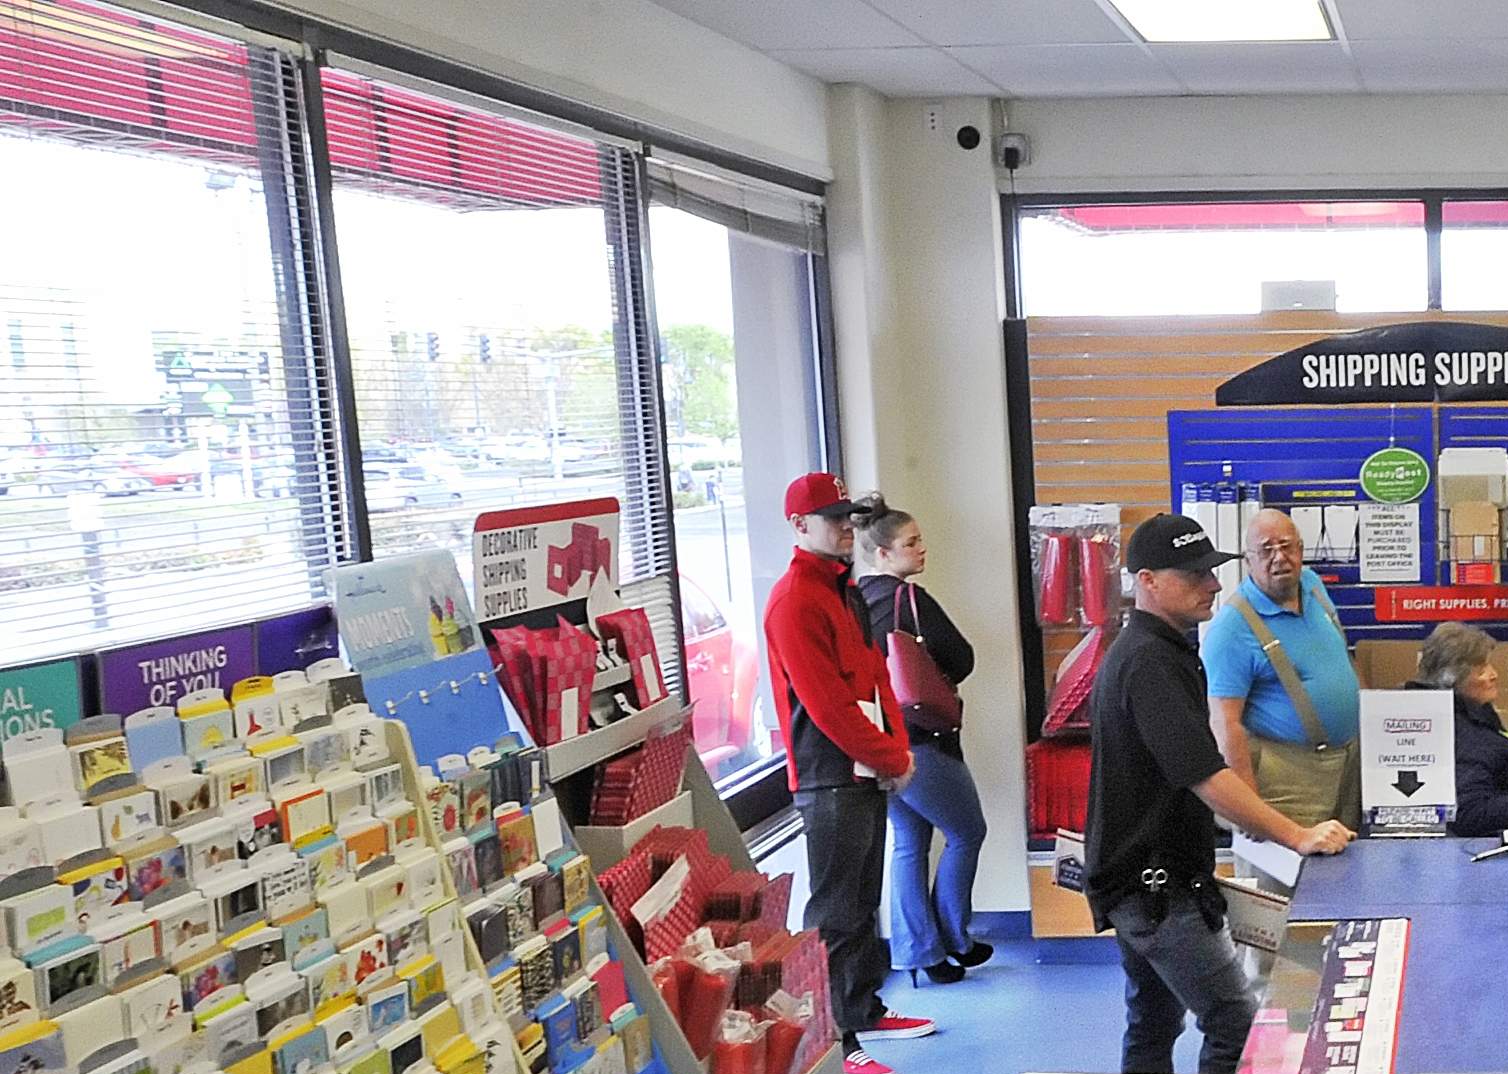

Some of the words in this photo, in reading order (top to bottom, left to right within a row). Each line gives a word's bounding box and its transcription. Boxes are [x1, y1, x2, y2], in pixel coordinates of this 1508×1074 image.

[1302, 352, 1426, 388] SHIPPING
[481, 525, 539, 558] DECORATIVE
[482, 558, 528, 588] SHIPPING
[484, 587, 528, 618] SUPPLIES
[1402, 598, 1436, 609] RIGHT
[138, 645, 228, 684] THINKING
[151, 684, 177, 707] OF
[182, 672, 221, 696] YOU
[1386, 721, 1427, 730] MAILING
[1396, 738, 1416, 746] LINE
[1378, 754, 1406, 764] (WAIT
[1407, 754, 1436, 764] HERE)
